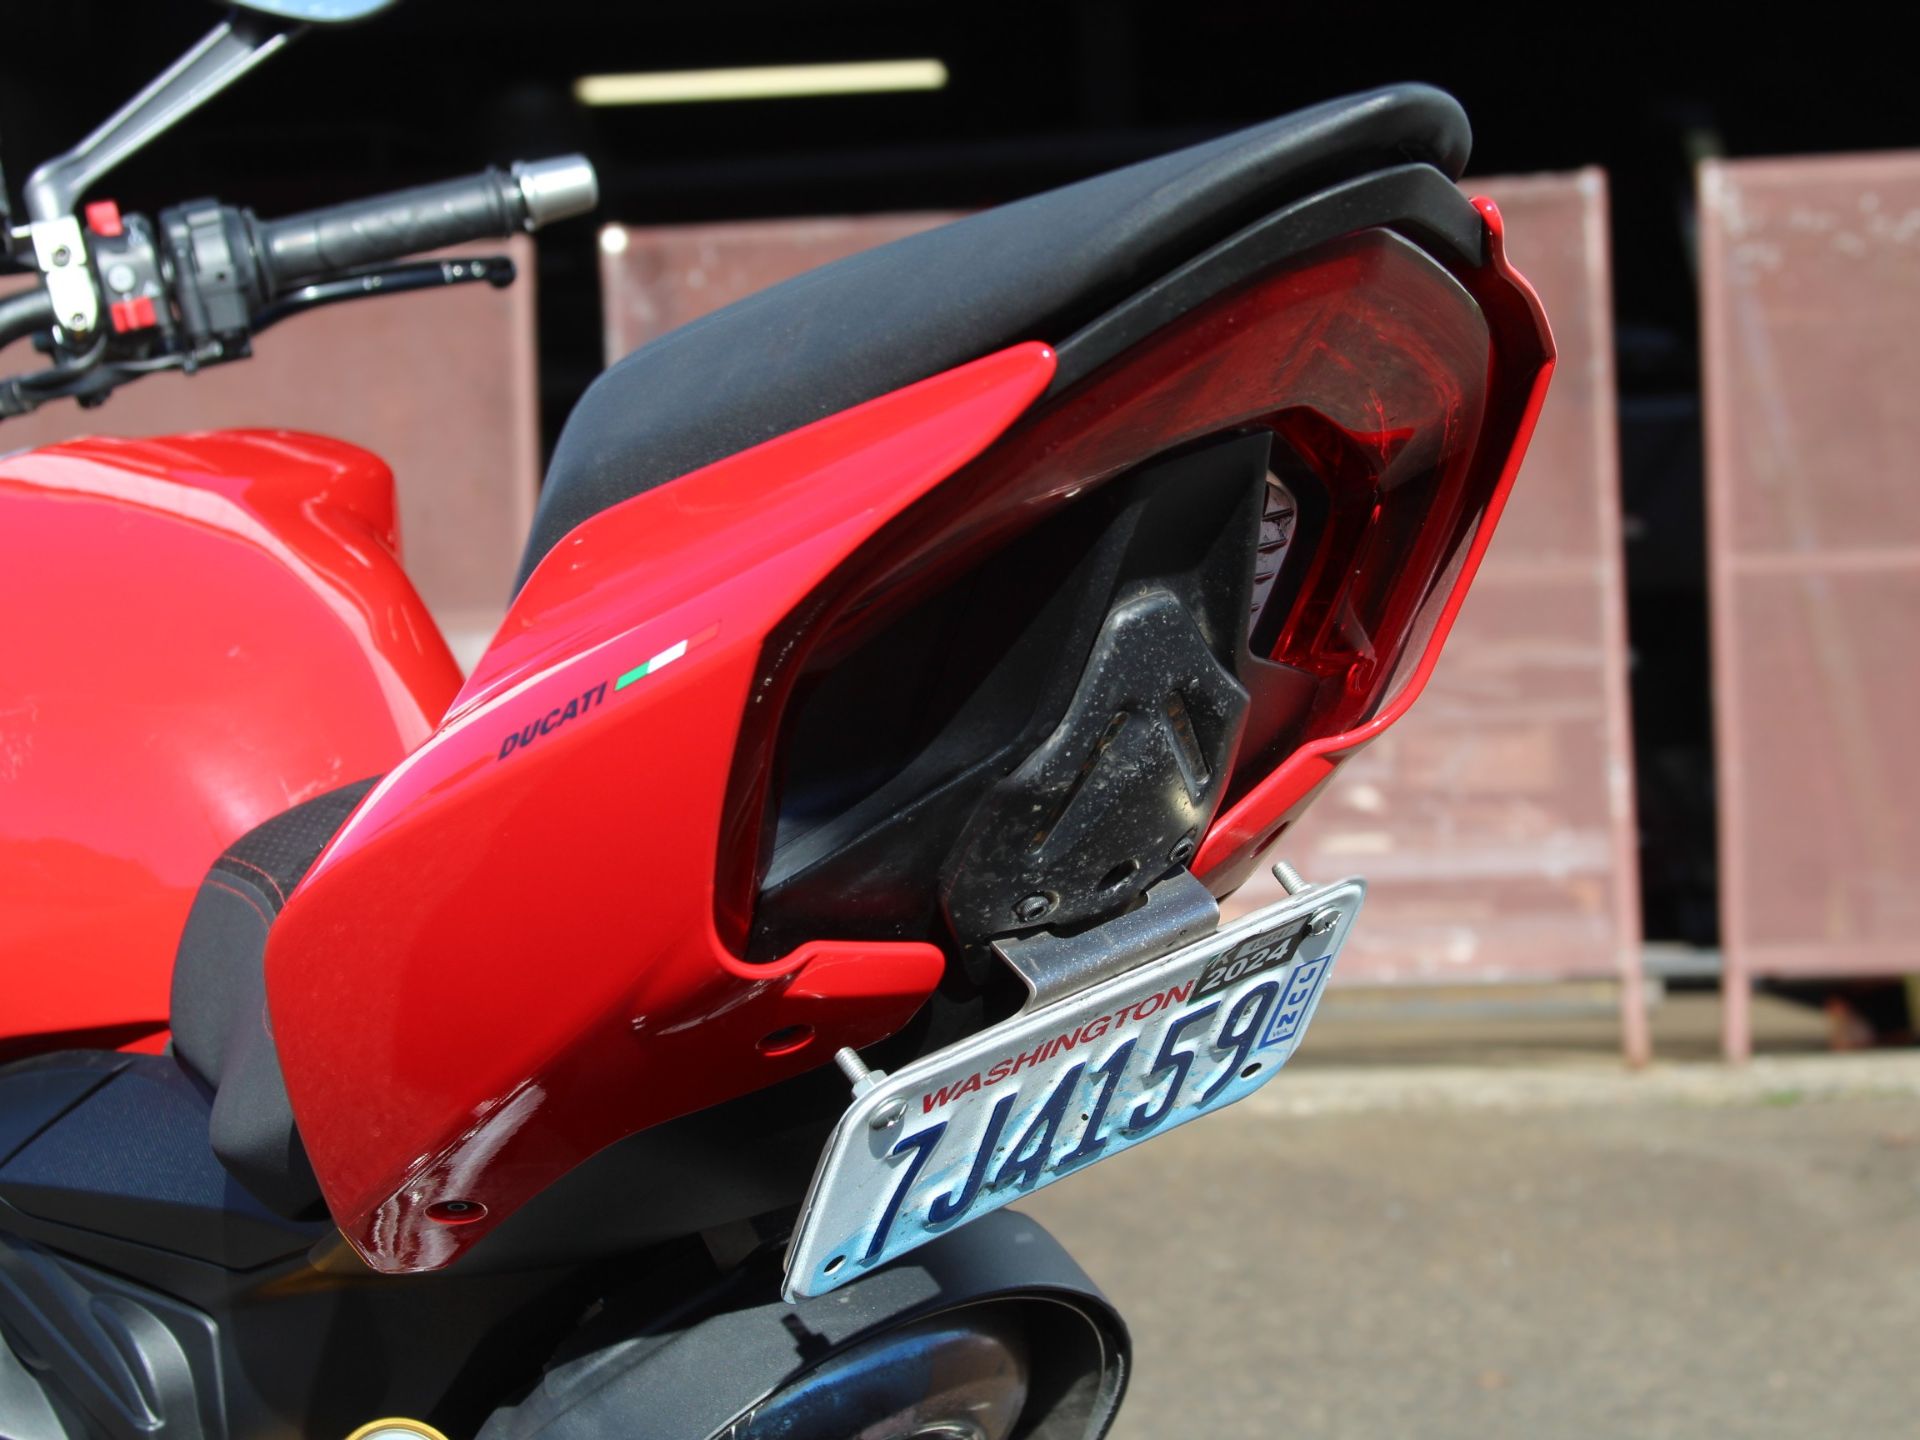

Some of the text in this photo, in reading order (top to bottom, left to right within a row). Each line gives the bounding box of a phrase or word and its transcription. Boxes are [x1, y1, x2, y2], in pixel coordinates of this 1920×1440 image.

[498, 681, 608, 761] DUCATI
[1200, 938, 1293, 993] 2024
[1276, 967, 1316, 1028] JUN
[922, 979, 1195, 1114] WASHINGTON
[861, 981, 1280, 1264] 7J4159
